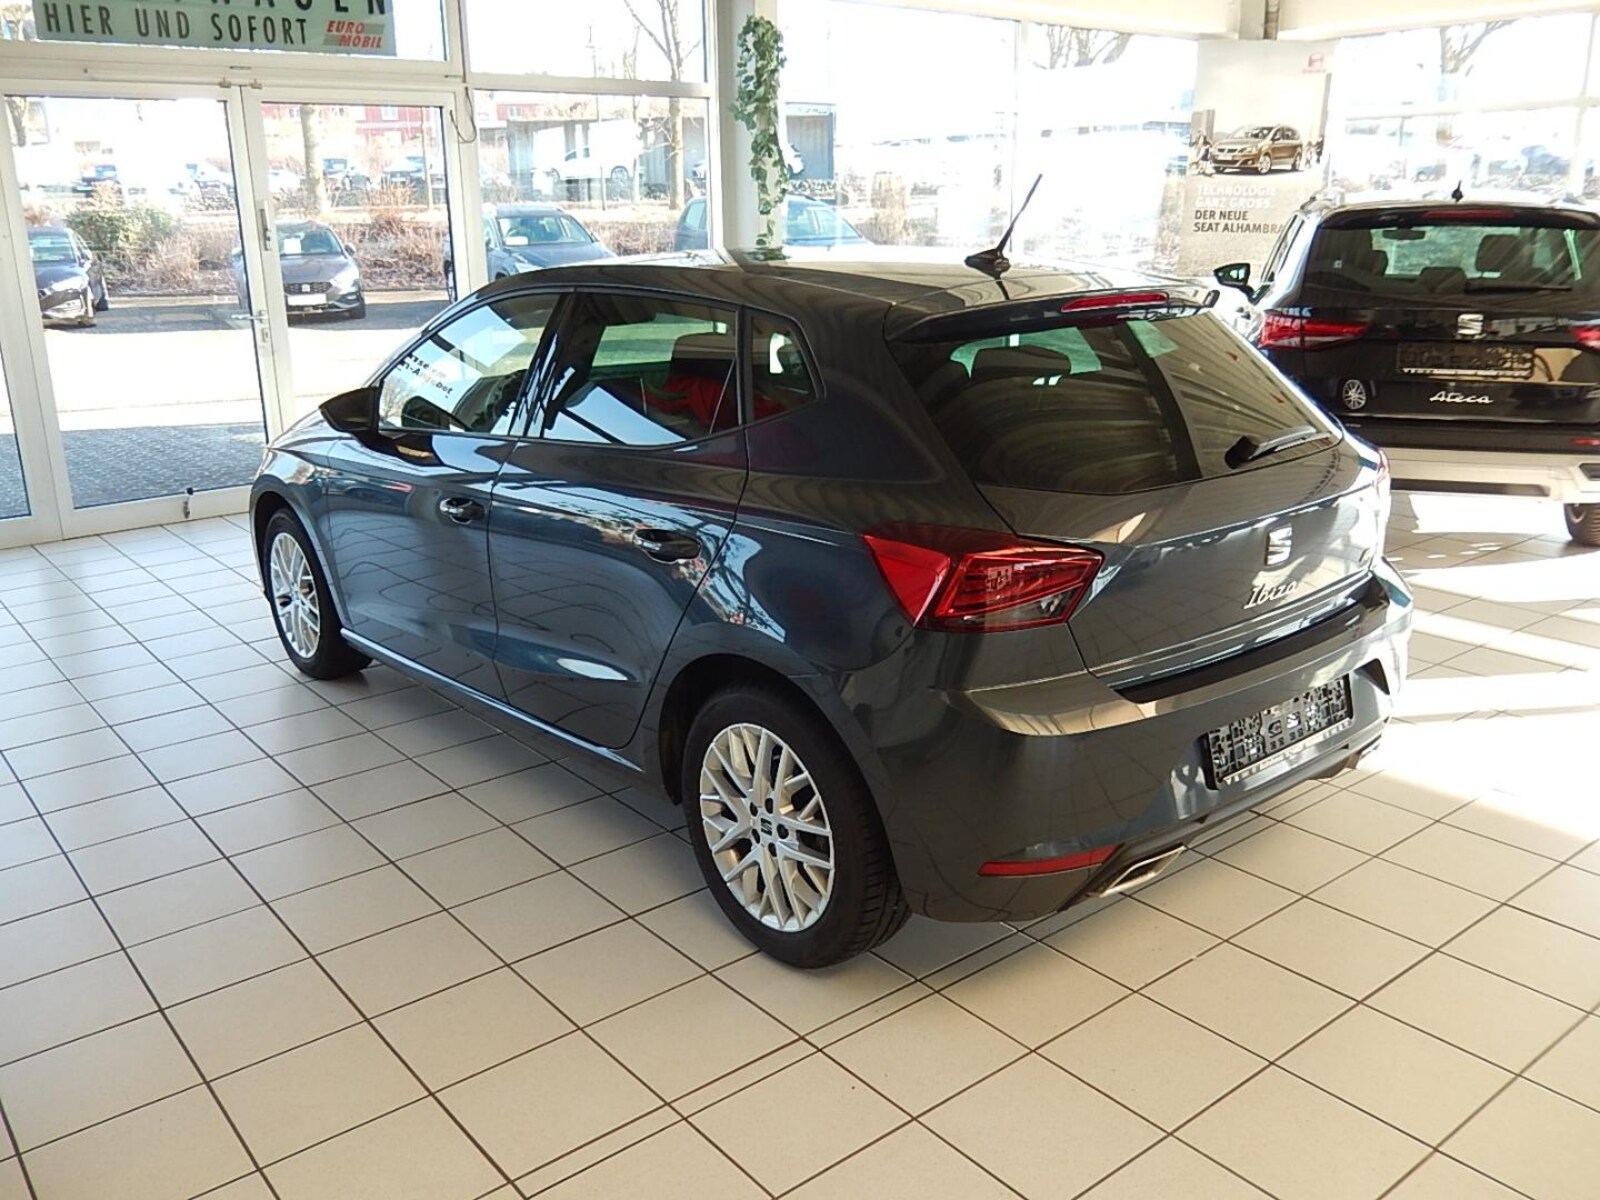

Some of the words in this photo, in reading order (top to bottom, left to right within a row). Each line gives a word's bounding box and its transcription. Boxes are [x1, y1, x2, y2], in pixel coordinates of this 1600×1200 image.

[44, 3, 113, 36] HIER
[135, 8, 190, 39] UND
[211, 13, 307, 45] SOFORT
[327, 20, 365, 34] EURO
[338, 35, 382, 48] MOBIL
[1195, 197, 1226, 208] GANZ
[1194, 209, 1217, 220] DER
[1218, 210, 1249, 221] NEUE
[1193, 221, 1221, 233] SEAT
[1430, 390, 1494, 404] Ateca
[1243, 580, 1297, 609] Ibiza
